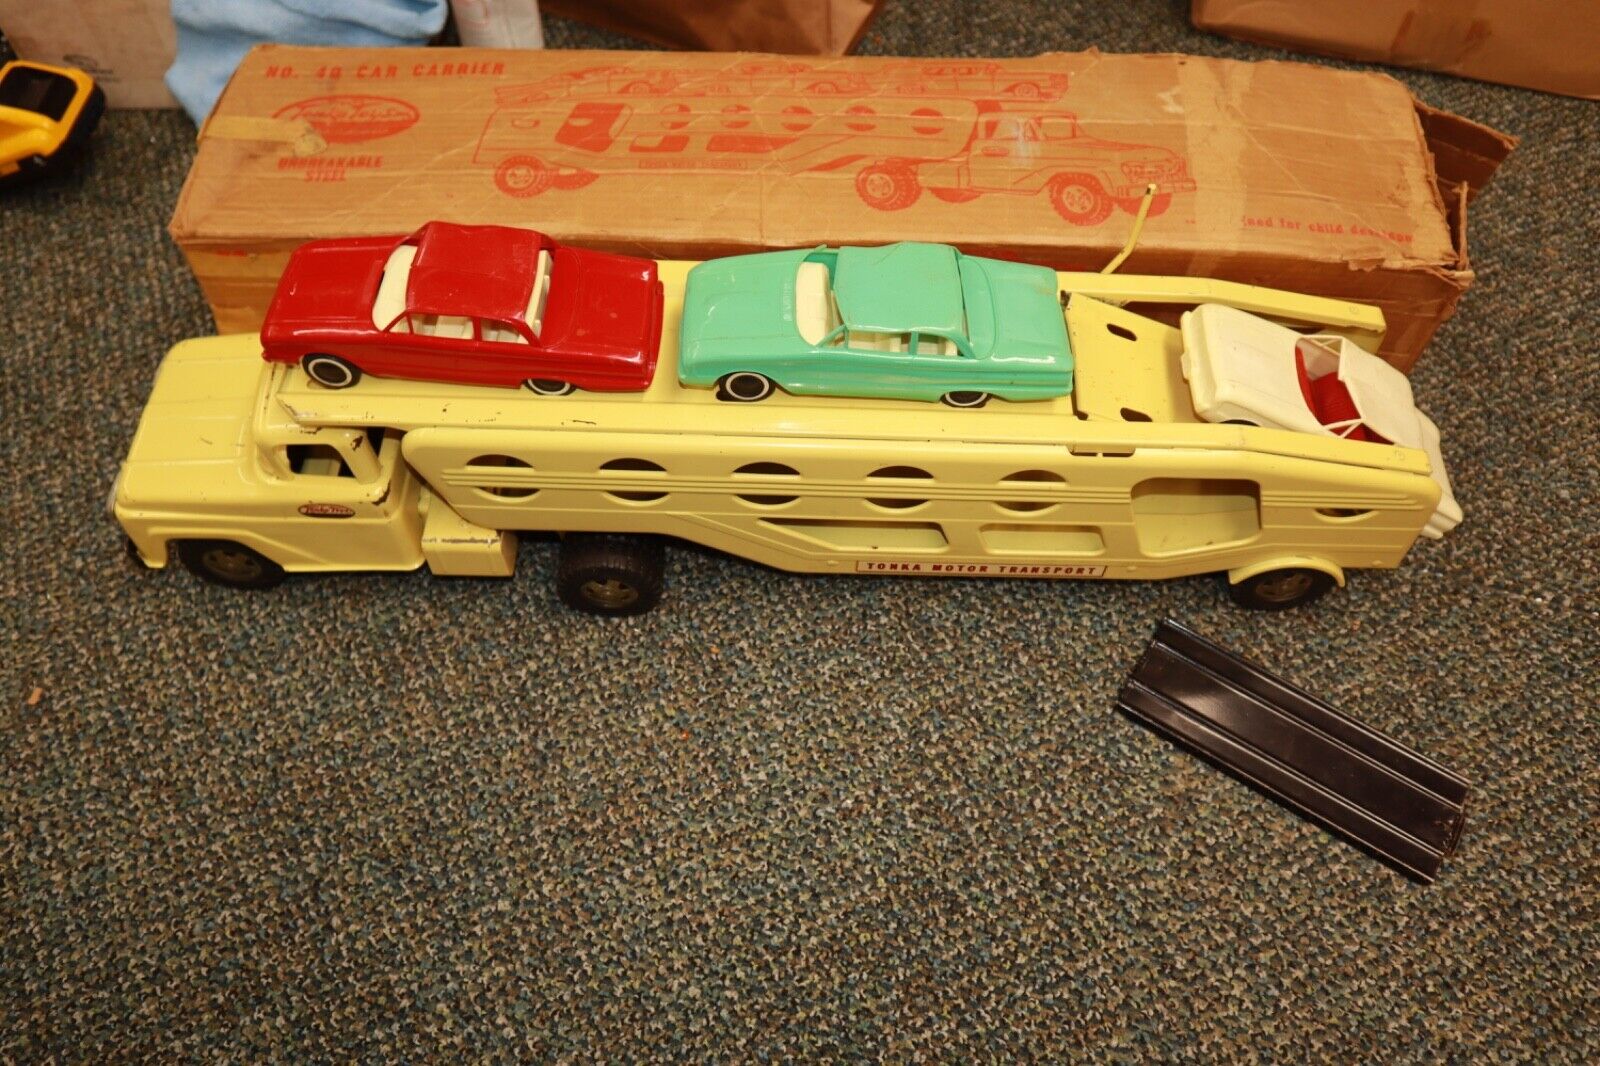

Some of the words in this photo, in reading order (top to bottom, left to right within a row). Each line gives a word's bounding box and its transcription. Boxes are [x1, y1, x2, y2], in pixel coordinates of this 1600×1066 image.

[265, 65, 299, 80] NO.
[356, 64, 398, 79] CAR
[412, 62, 508, 78] CARRIER
[1308, 221, 1345, 235] child
[866, 561, 922, 572] TONKA
[931, 563, 989, 574] MOTOR
[999, 565, 1097, 576] TRANSPORT
